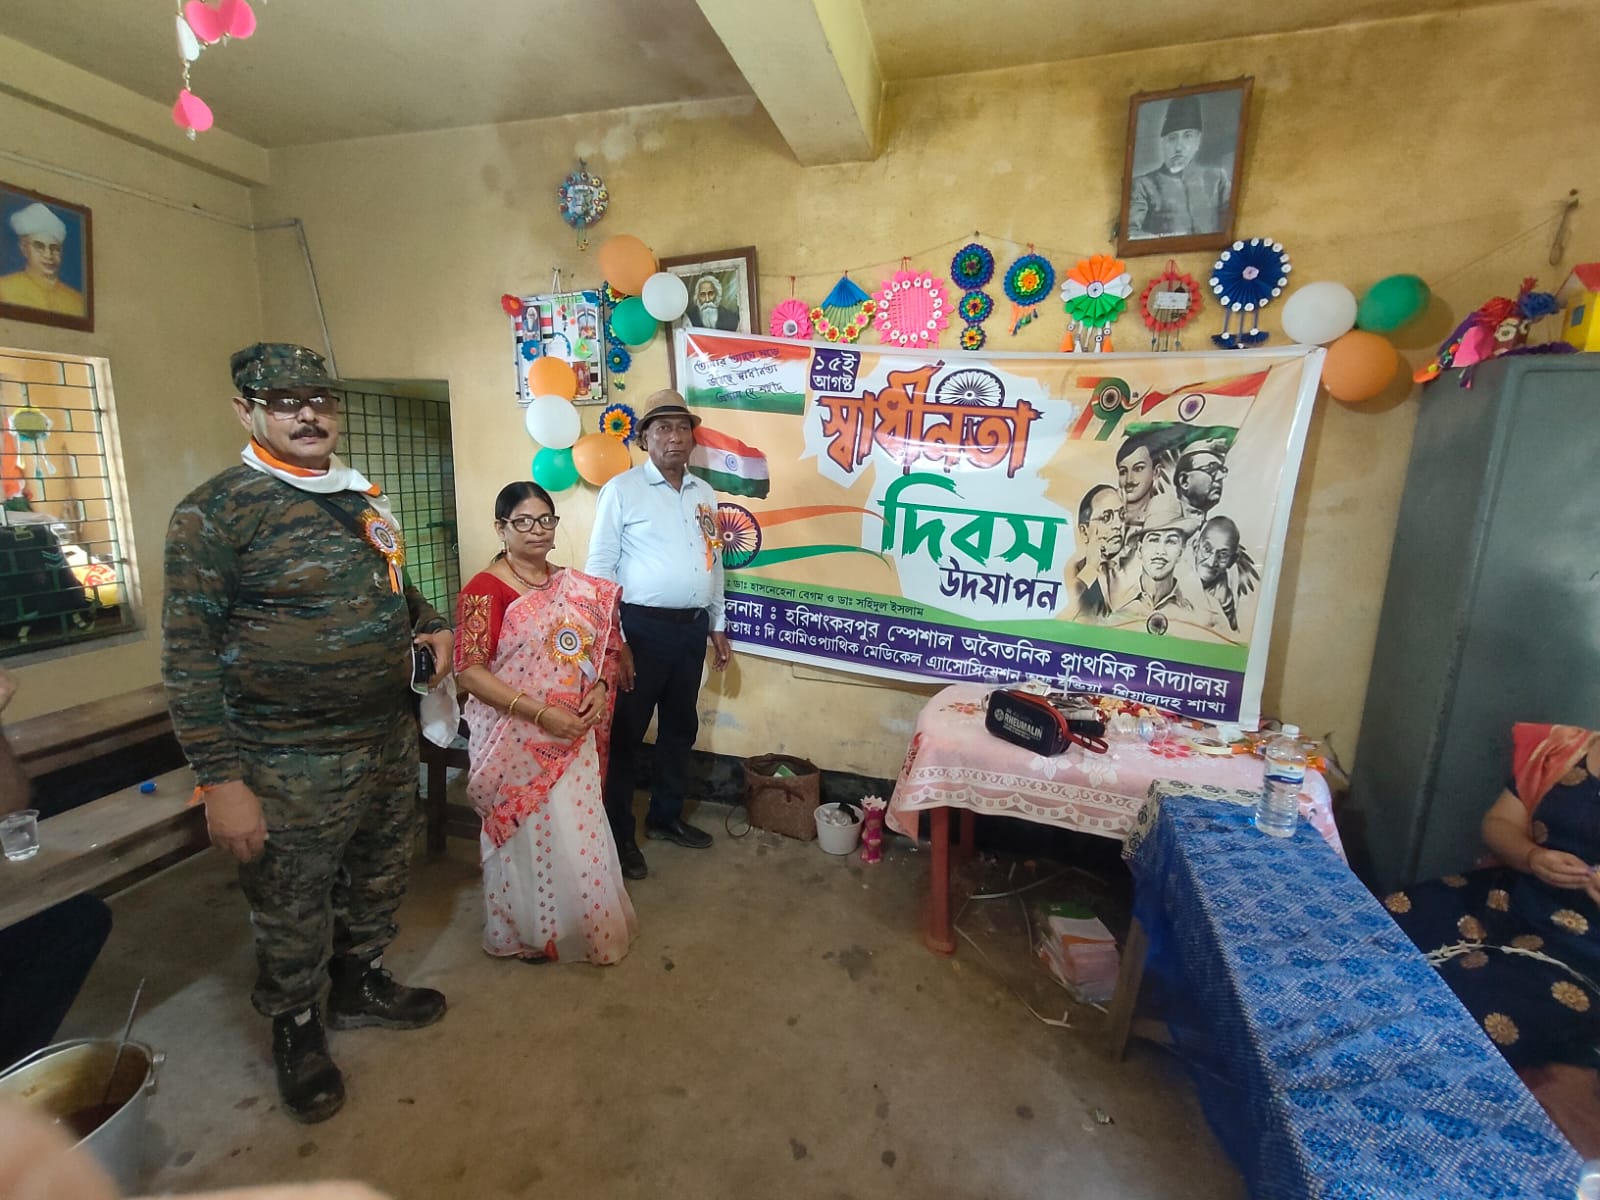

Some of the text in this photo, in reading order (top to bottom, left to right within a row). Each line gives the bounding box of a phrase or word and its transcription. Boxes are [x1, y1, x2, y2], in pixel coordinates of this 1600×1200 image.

[814, 360, 1045, 478] স্বাধীনতা
[876, 472, 1068, 576] দিবস
[798, 590, 824, 600] বেগম
[827, 594, 834, 602] ও
[838, 595, 853, 606] ডাঃ
[856, 597, 888, 612] সহিদুল
[889, 600, 925, 616] ইসলাম
[938, 557, 1062, 612] উদযাপন
[764, 622, 775, 639] দি
[779, 628, 859, 654] হোমিওপ্যাথিক
[864, 642, 923, 666] মেডিকেল
[1187, 699, 1226, 714] শাখা
[784, 605, 880, 643] হরিশংকরপুর
[888, 625, 954, 652] স্পেশাল
[960, 633, 1053, 667] অবৈতনিক
[1061, 652, 1138, 682] প্রাথমিক
[1146, 661, 1230, 698] বিদ্যালয়
[1004, 712, 1043, 739] RHEUMALIN
